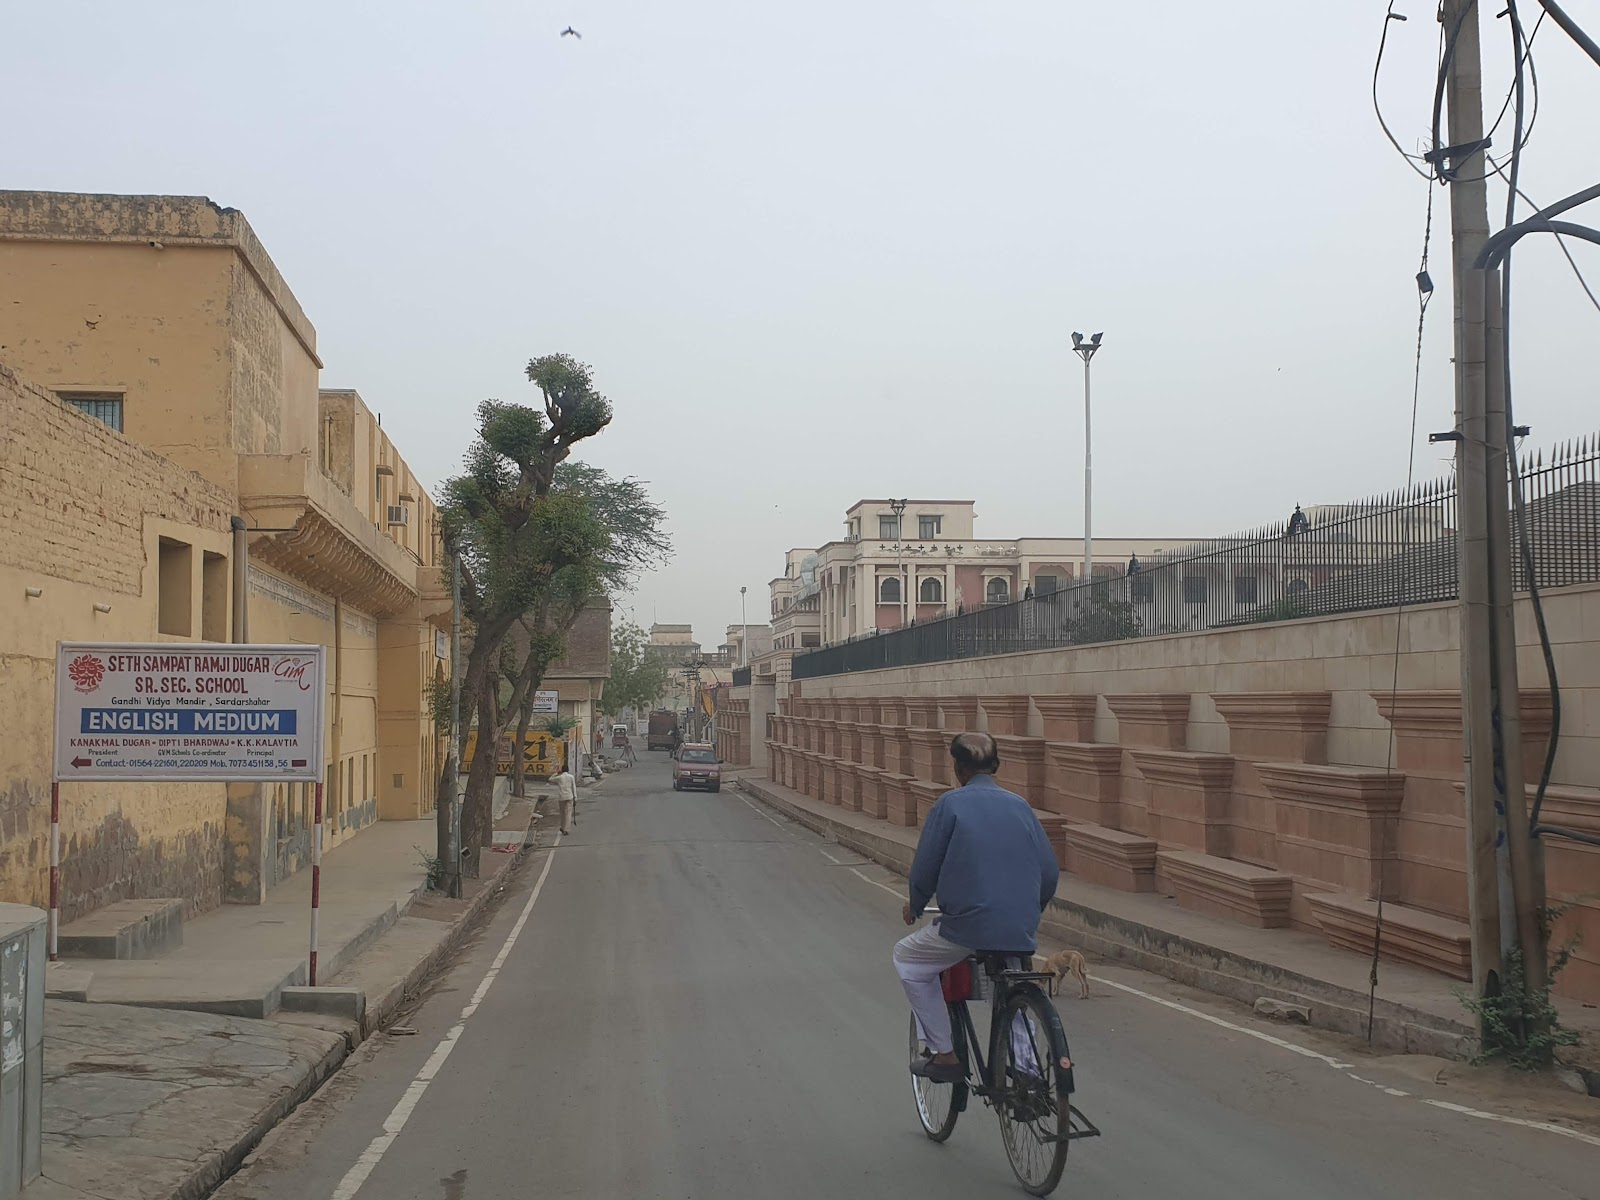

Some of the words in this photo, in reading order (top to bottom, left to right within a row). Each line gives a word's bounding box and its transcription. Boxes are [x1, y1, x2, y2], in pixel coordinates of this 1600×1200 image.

[108, 655, 141, 672] SETH
[143, 655, 192, 672] SAMPAT
[194, 656, 230, 673] RAMJI
[232, 656, 270, 673] DUGAR
[135, 676, 158, 693] SR.
[160, 676, 191, 693] SEC.
[195, 677, 248, 694] SCHOOL
[111, 696, 142, 705] Gandhi
[146, 696, 171, 708] Vidya
[215, 697, 271, 706] Sardarshahar
[89, 711, 179, 731] ENGLISH
[194, 712, 280, 731] MEDIUM
[70, 738, 120, 747] KANAKMAL
[122, 738, 151, 747] DUGAR
[158, 738, 181, 747] DIPTI
[183, 738, 230, 747] BHARDWAJ
[88, 748, 118, 756] President
[246, 749, 275, 757] Principal
